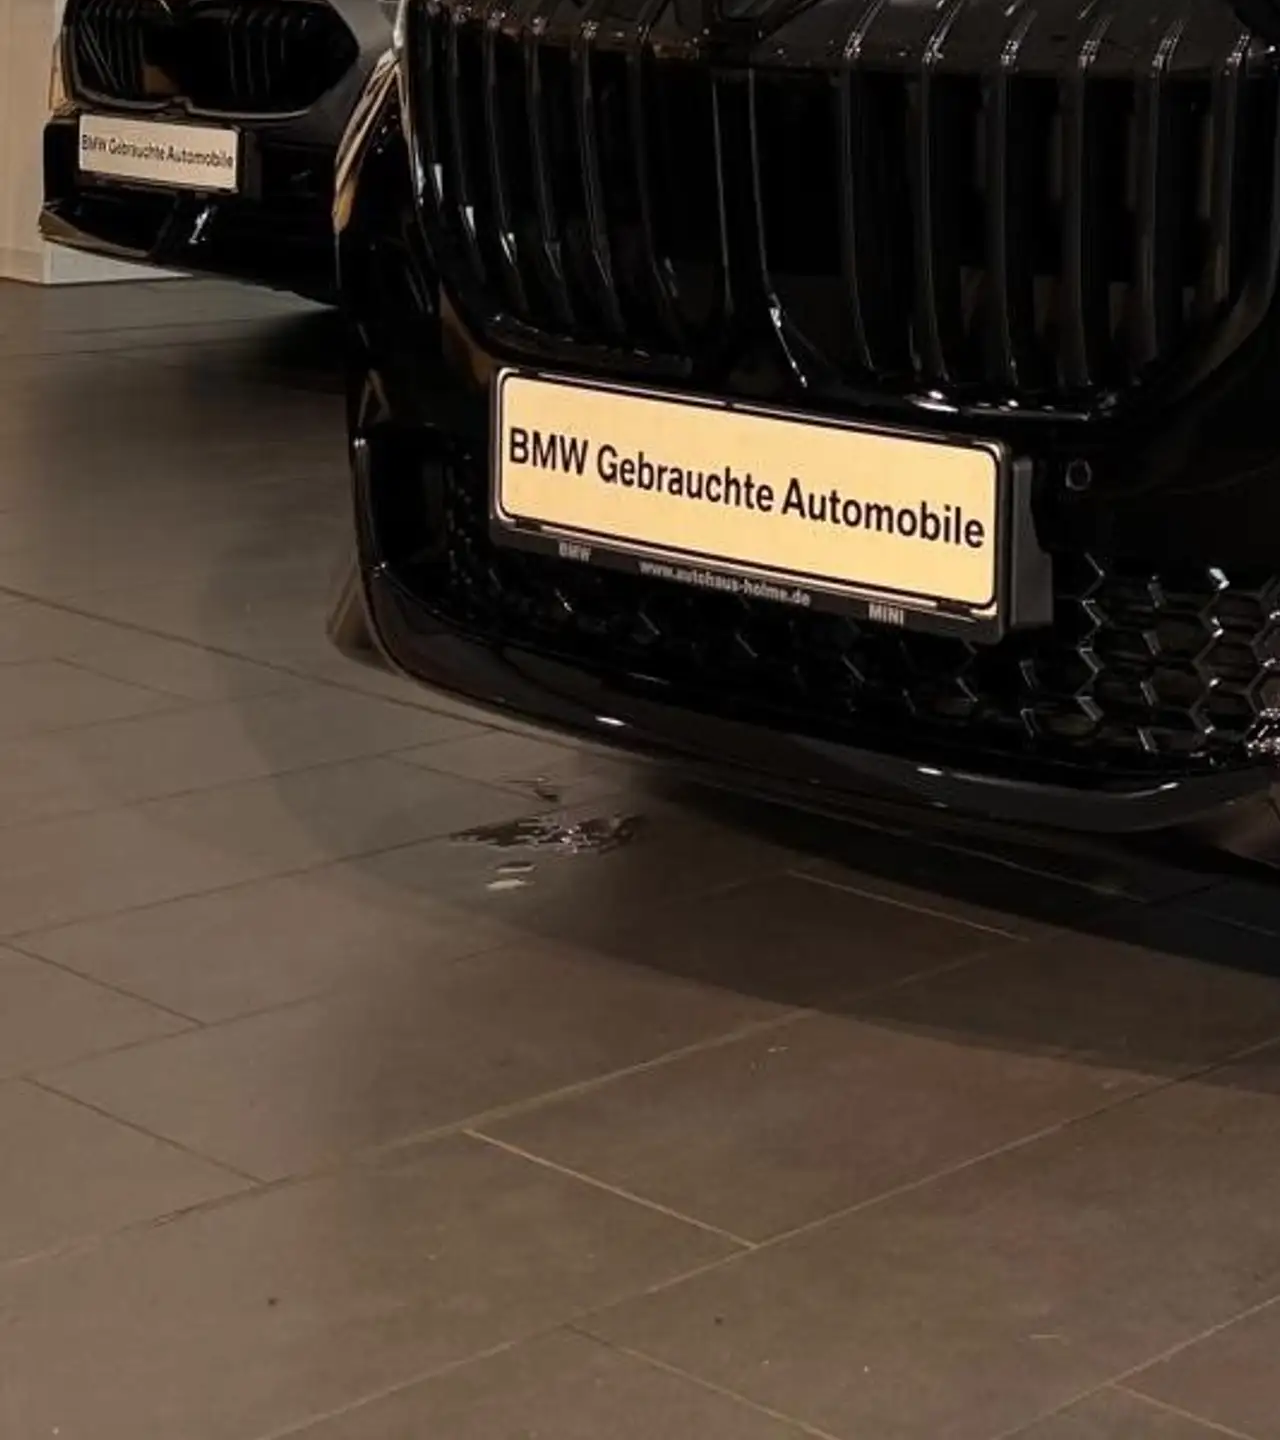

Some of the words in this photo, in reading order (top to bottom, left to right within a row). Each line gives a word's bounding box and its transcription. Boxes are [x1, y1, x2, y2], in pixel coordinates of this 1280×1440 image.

[508, 426, 588, 475] BMW
[597, 443, 774, 513] Gebrauchte
[782, 477, 985, 549] Automobile
[557, 541, 592, 563] BMW
[868, 603, 905, 627] MINI
